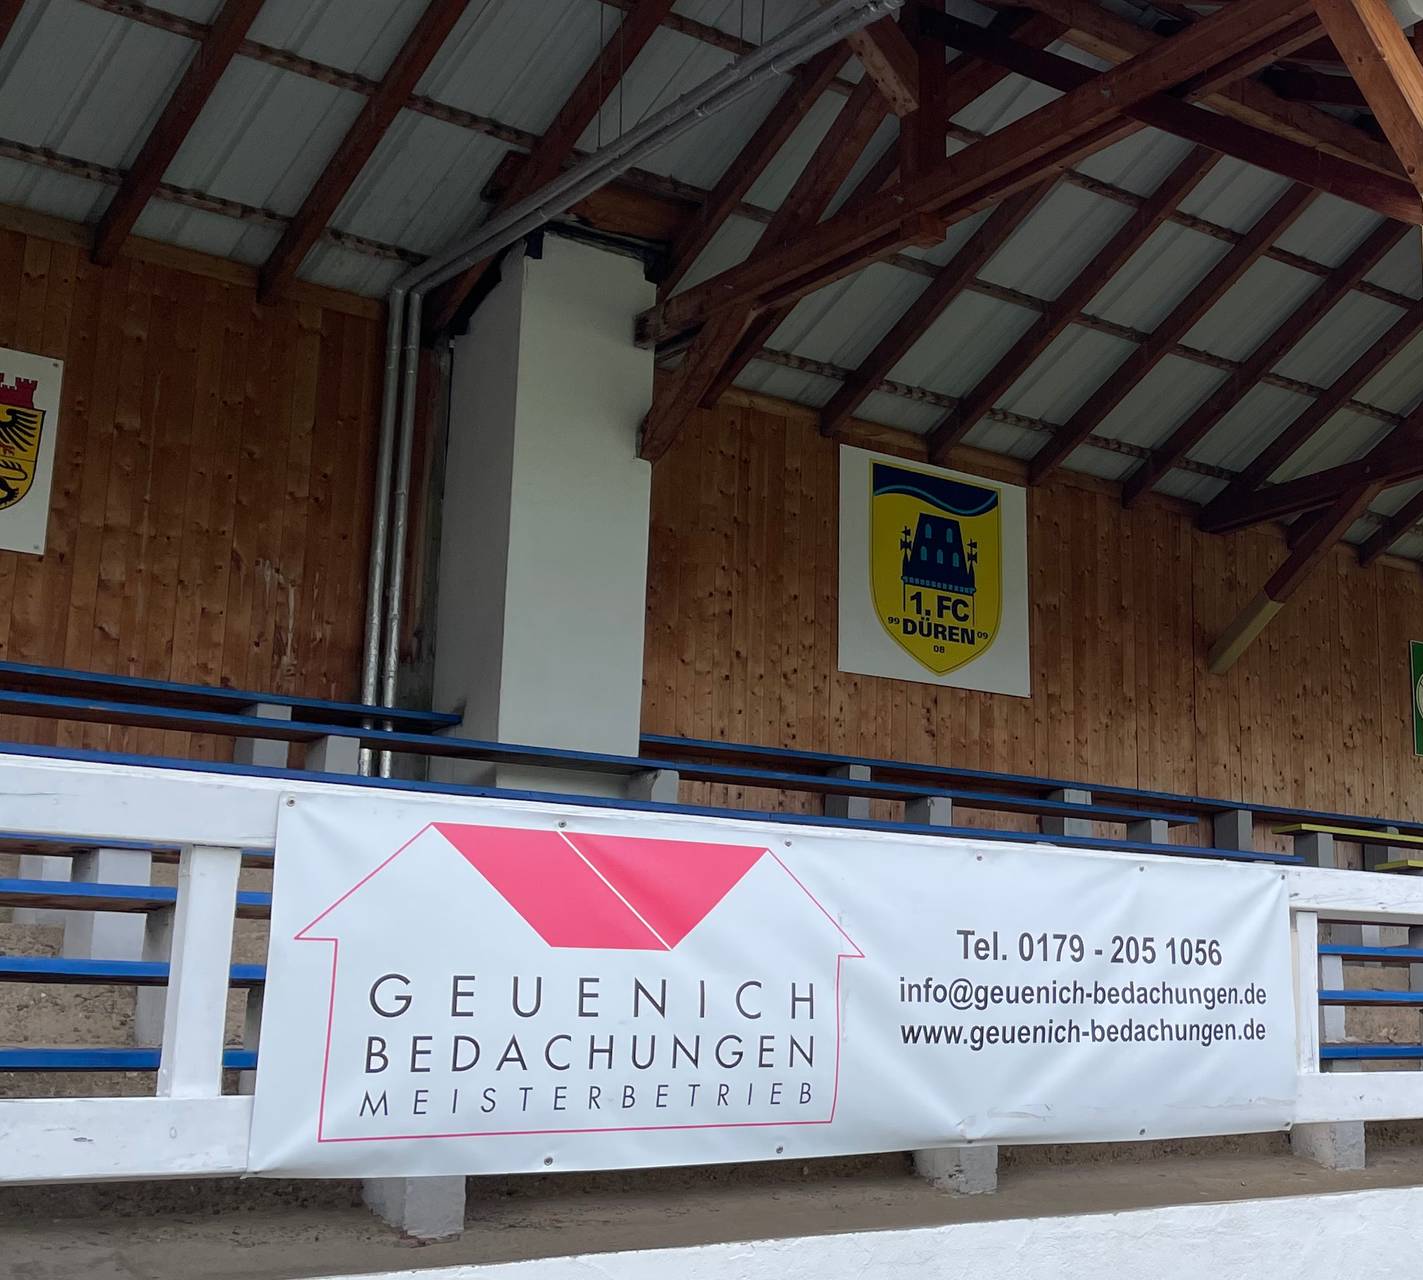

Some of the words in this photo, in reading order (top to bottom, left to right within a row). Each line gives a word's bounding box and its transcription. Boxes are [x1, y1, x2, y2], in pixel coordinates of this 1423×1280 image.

[910, 591, 931, 616] 1.
[937, 595, 970, 622] FC
[902, 616, 976, 645] DÜREN
[956, 929, 1008, 961] Tel.
[1018, 931, 1085, 963] 0179
[1110, 935, 1157, 965] 205
[1165, 936, 1222, 966] 1056
[369, 973, 815, 1021] GEUENICH
[899, 976, 1267, 1011] info@geuenich-bedachungen.de
[900, 1018, 1266, 1050] www.geuenich-bedachungen.de
[366, 1033, 815, 1074] BEDACHUNGEN
[359, 1082, 813, 1118] MEISTERBETRIEB
